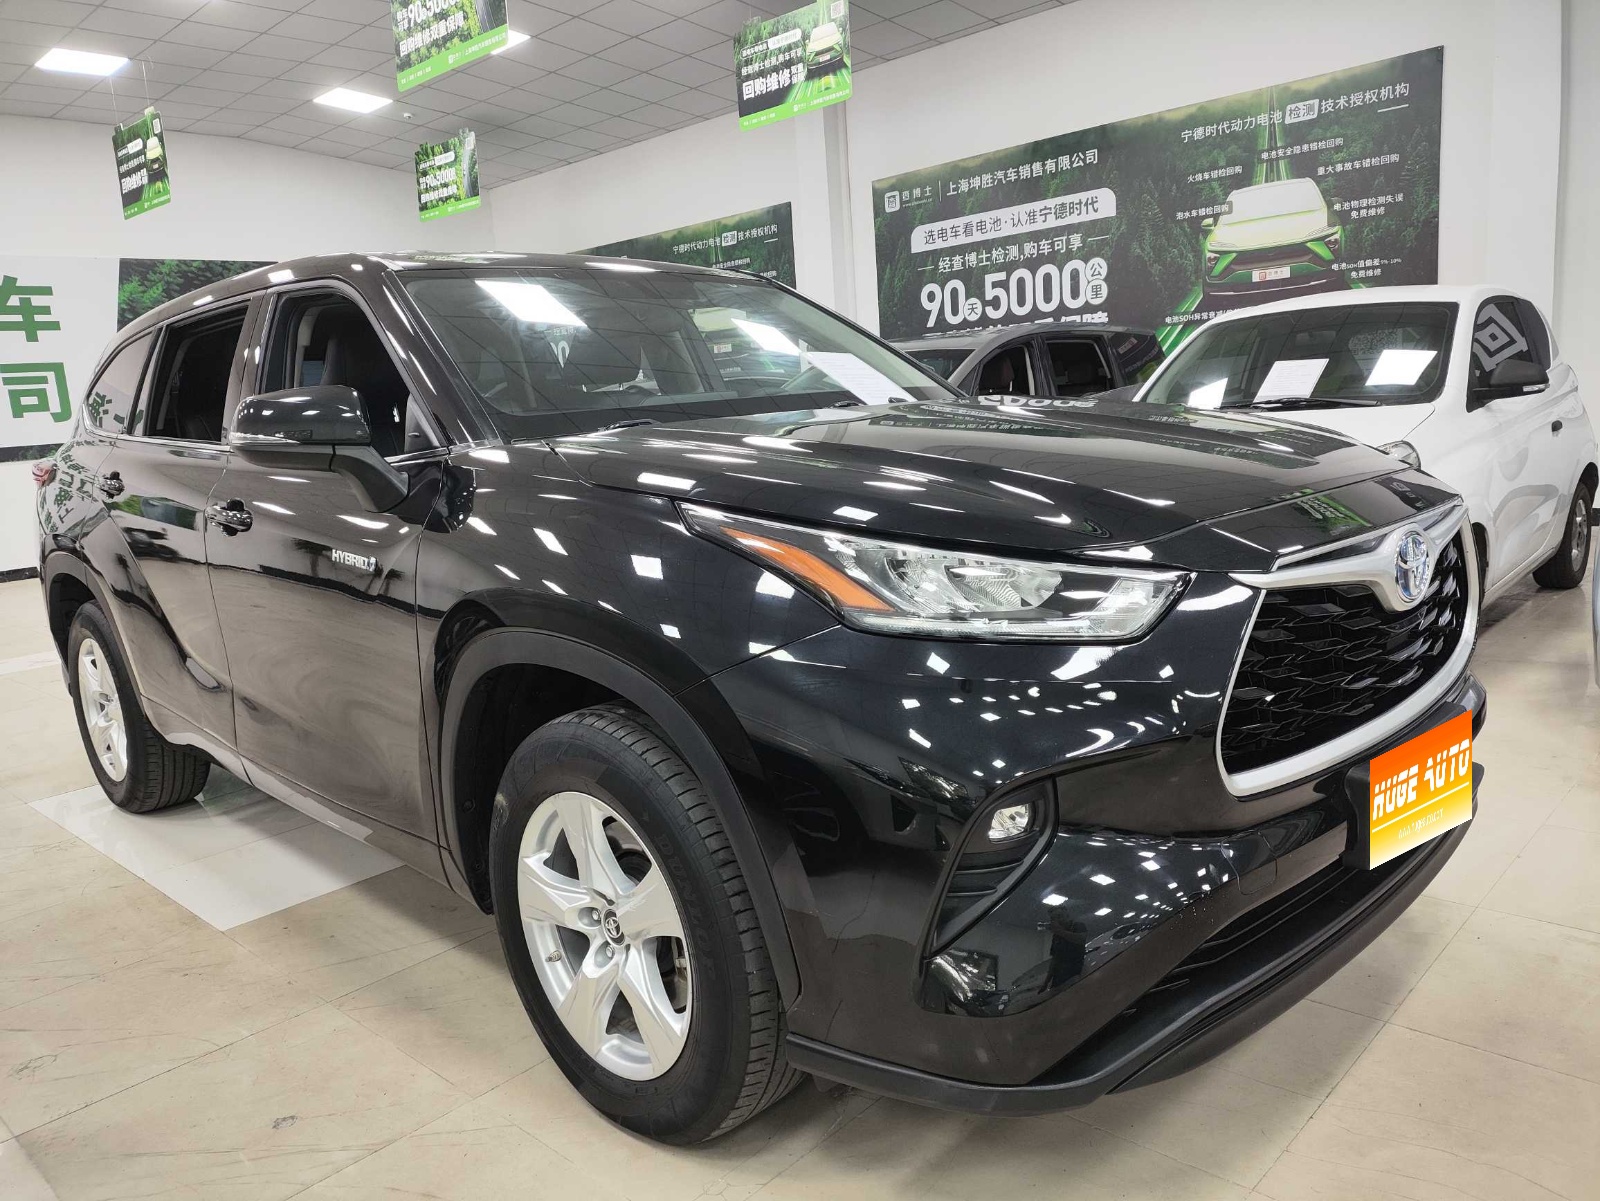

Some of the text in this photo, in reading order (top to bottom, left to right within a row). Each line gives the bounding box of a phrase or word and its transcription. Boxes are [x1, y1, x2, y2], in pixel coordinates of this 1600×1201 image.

[742, 69, 791, 100] 回购维修
[1261, 137, 1344, 161] 电池安全隐患错检回购
[946, 148, 1099, 196] 上海坤胜汽车销售有限公司
[1317, 153, 1400, 176] 重大事故车错检回购
[1333, 192, 1404, 212] 电池物理检测失误
[1350, 206, 1386, 220] 免费维修
[1350, 268, 1382, 279] 免费维修
[0, 275, 61, 342] 车
[0, 362, 72, 423] 司
[332, 549, 369, 570] HYBRID
